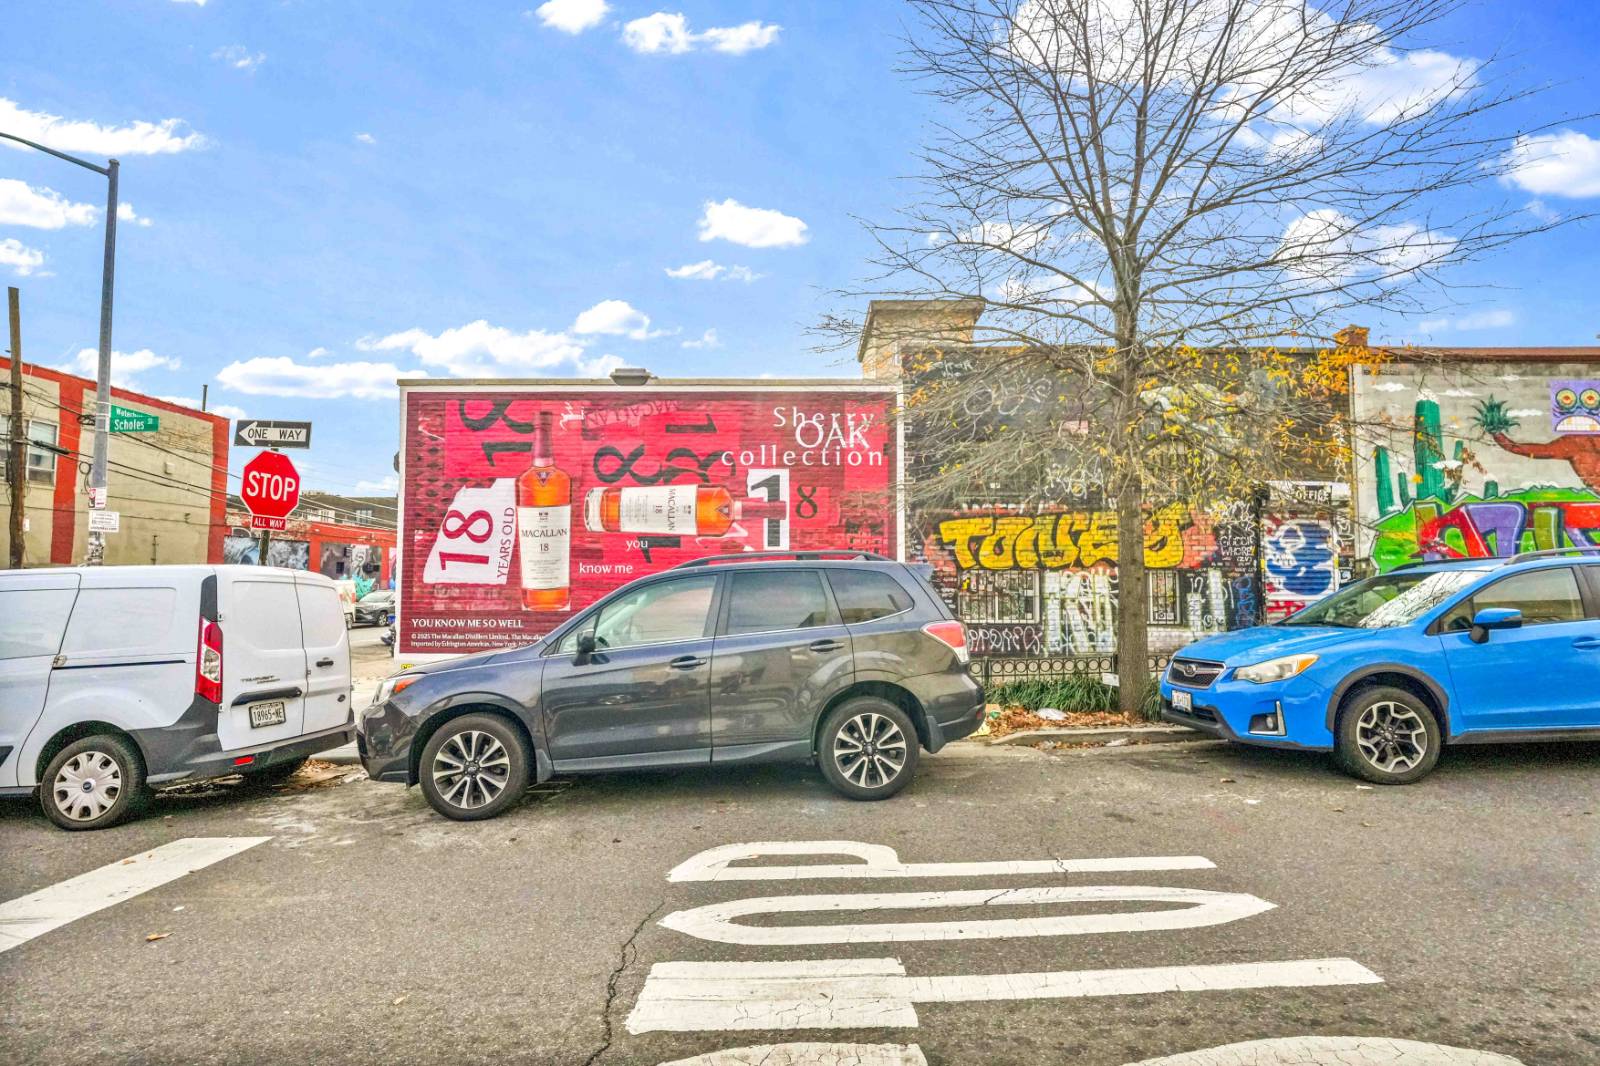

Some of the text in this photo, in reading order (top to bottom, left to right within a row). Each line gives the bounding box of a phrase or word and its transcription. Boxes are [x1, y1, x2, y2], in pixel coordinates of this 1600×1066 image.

[114, 419, 145, 430] Scholes
[773, 407, 874, 432] Sherry
[247, 428, 302, 440] ONE WAY
[795, 420, 870, 448] OAK
[721, 445, 882, 466] collection
[246, 471, 296, 502] STOP
[254, 517, 284, 528] ALL WAY
[521, 528, 567, 537] MACALLAN
[439, 510, 494, 571] 18
[497, 506, 515, 578] YEARS OLD
[626, 539, 648, 551] you
[540, 543, 549, 552] 18
[579, 562, 633, 574] know me
[411, 618, 524, 628] YOU KNOW ME SO WELL
